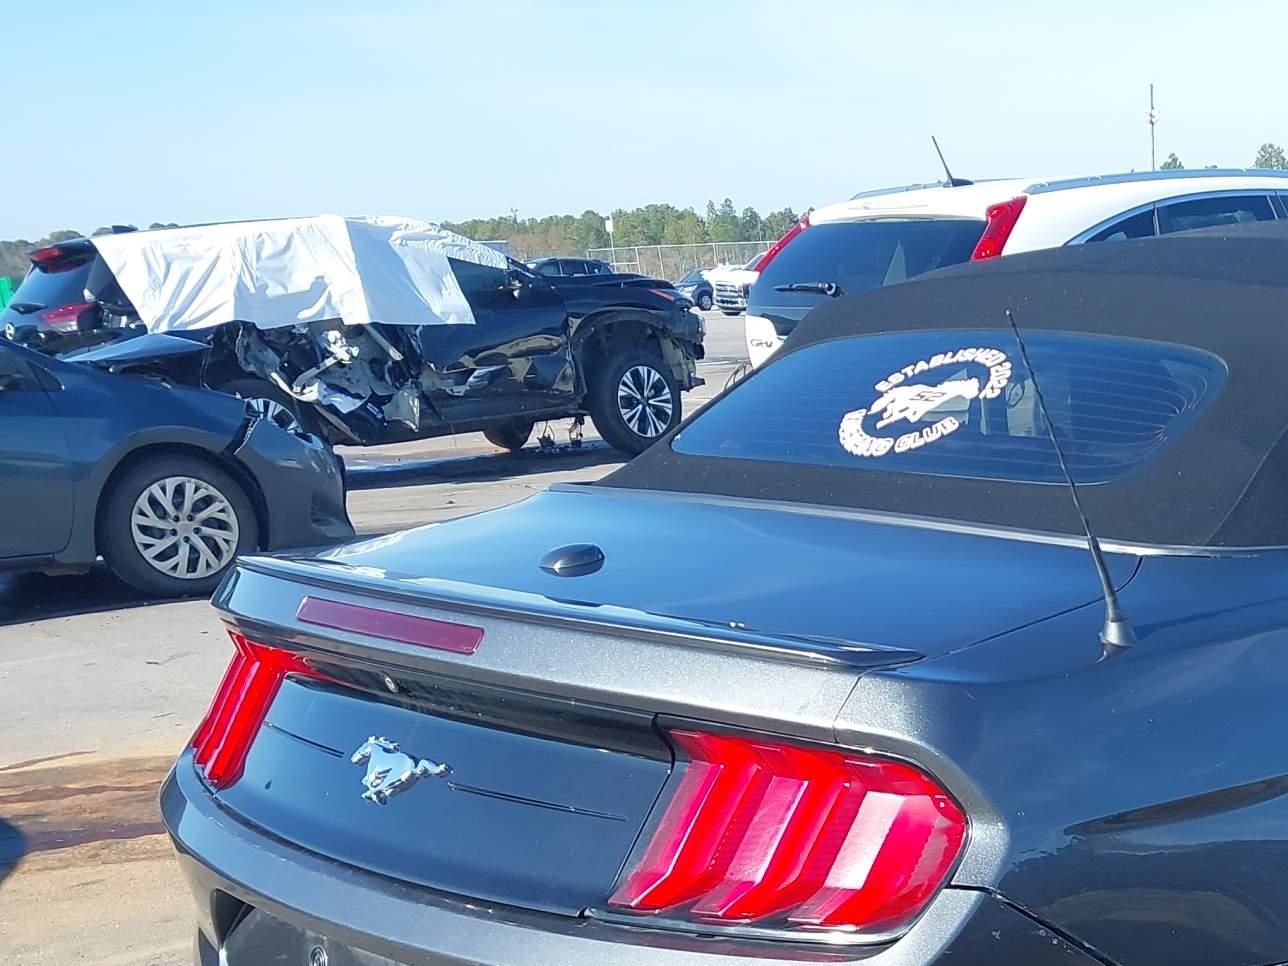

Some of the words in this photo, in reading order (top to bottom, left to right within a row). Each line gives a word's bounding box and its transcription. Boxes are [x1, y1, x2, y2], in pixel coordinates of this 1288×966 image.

[874, 347, 1006, 392] ESTABLISHED
[979, 361, 1012, 399] 2022
[894, 416, 960, 454] CLUB
